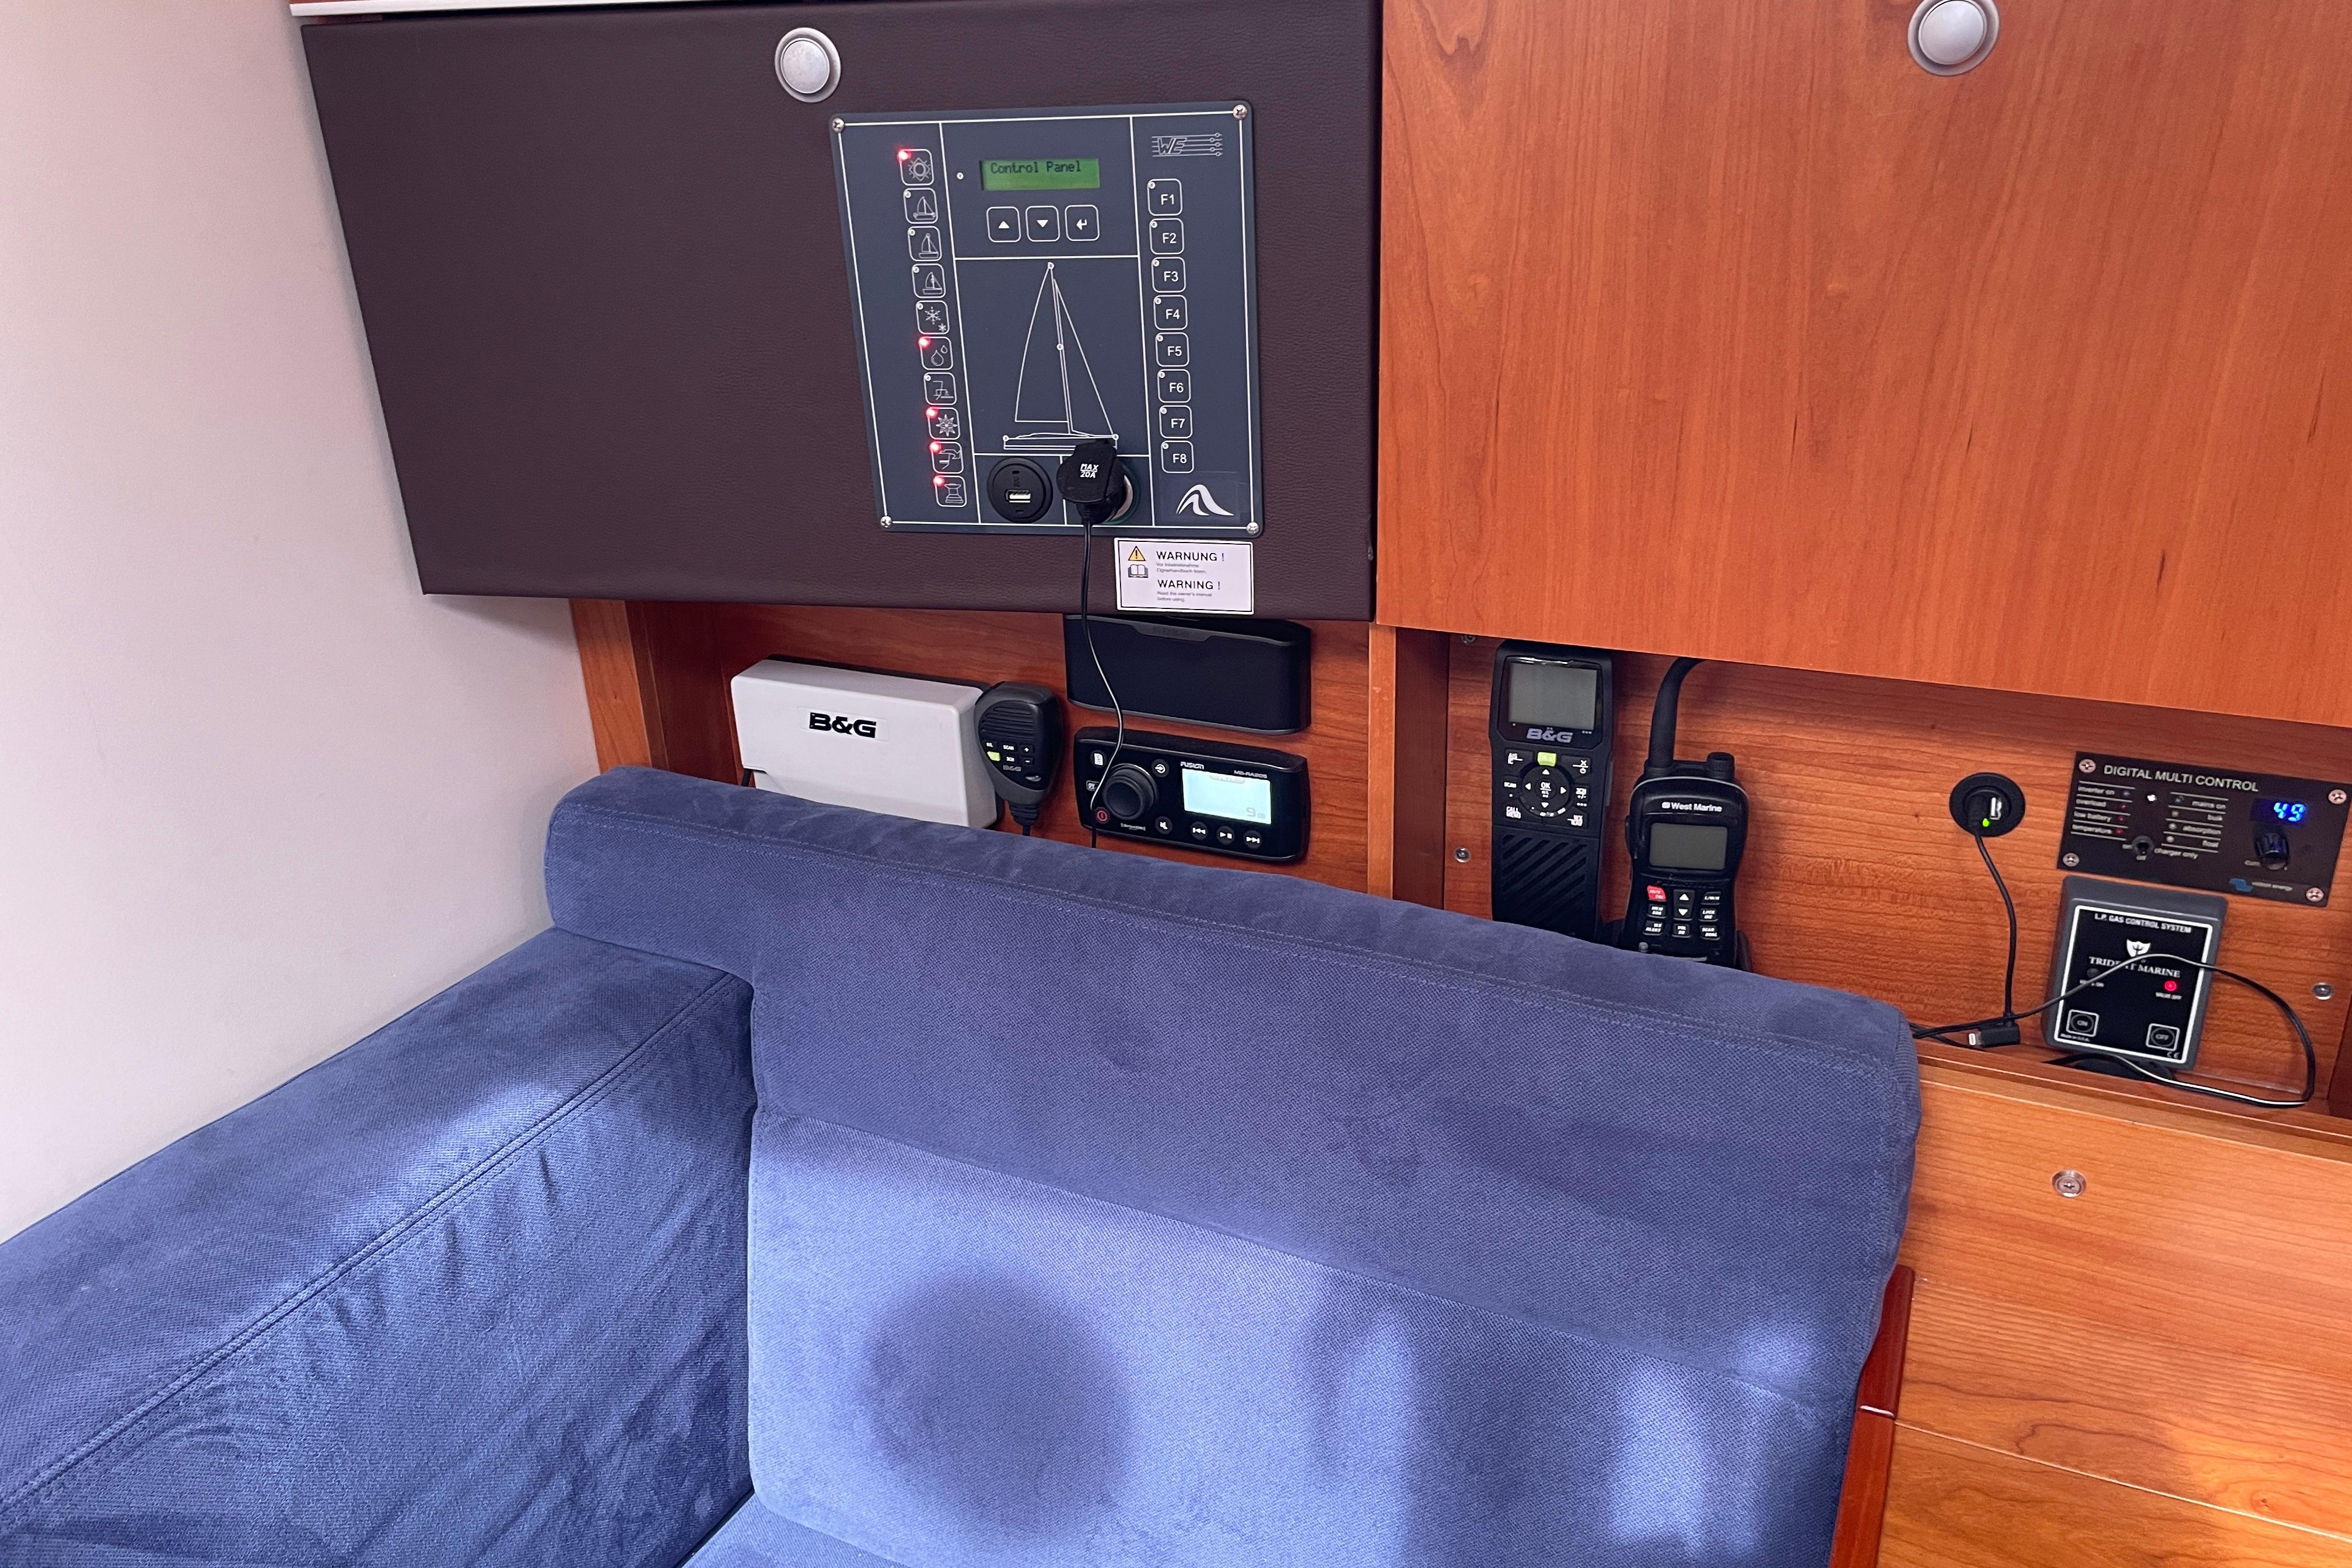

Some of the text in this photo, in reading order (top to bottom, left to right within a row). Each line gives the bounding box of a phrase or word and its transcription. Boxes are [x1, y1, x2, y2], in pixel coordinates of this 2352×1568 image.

[991, 160, 1082, 174] Control Panel
[1160, 194, 1175, 205] F1
[1162, 232, 1177, 244] F2
[1163, 271, 1179, 282] F3
[1166, 309, 1180, 320] F4
[1167, 345, 1182, 357] F5
[1169, 382, 1184, 393] F6
[1171, 418, 1185, 429] F7
[1172, 453, 1187, 464] F8
[1156, 551, 1218, 561] WARNUNG
[1157, 579, 1213, 590] WARNING
[809, 712, 876, 738] B&G
[1526, 728, 1573, 743] B&G
[2103, 764, 2259, 792] DIGITAL MULTI CONTROL
[1671, 802, 1722, 812] West Marine
[2273, 802, 2306, 822] 49
[2108, 915, 2124, 923] GAS
[2125, 918, 2160, 929] CONTROL
[2161, 922, 2192, 933] SYSTEM
[2137, 964, 2181, 979] MARINE
